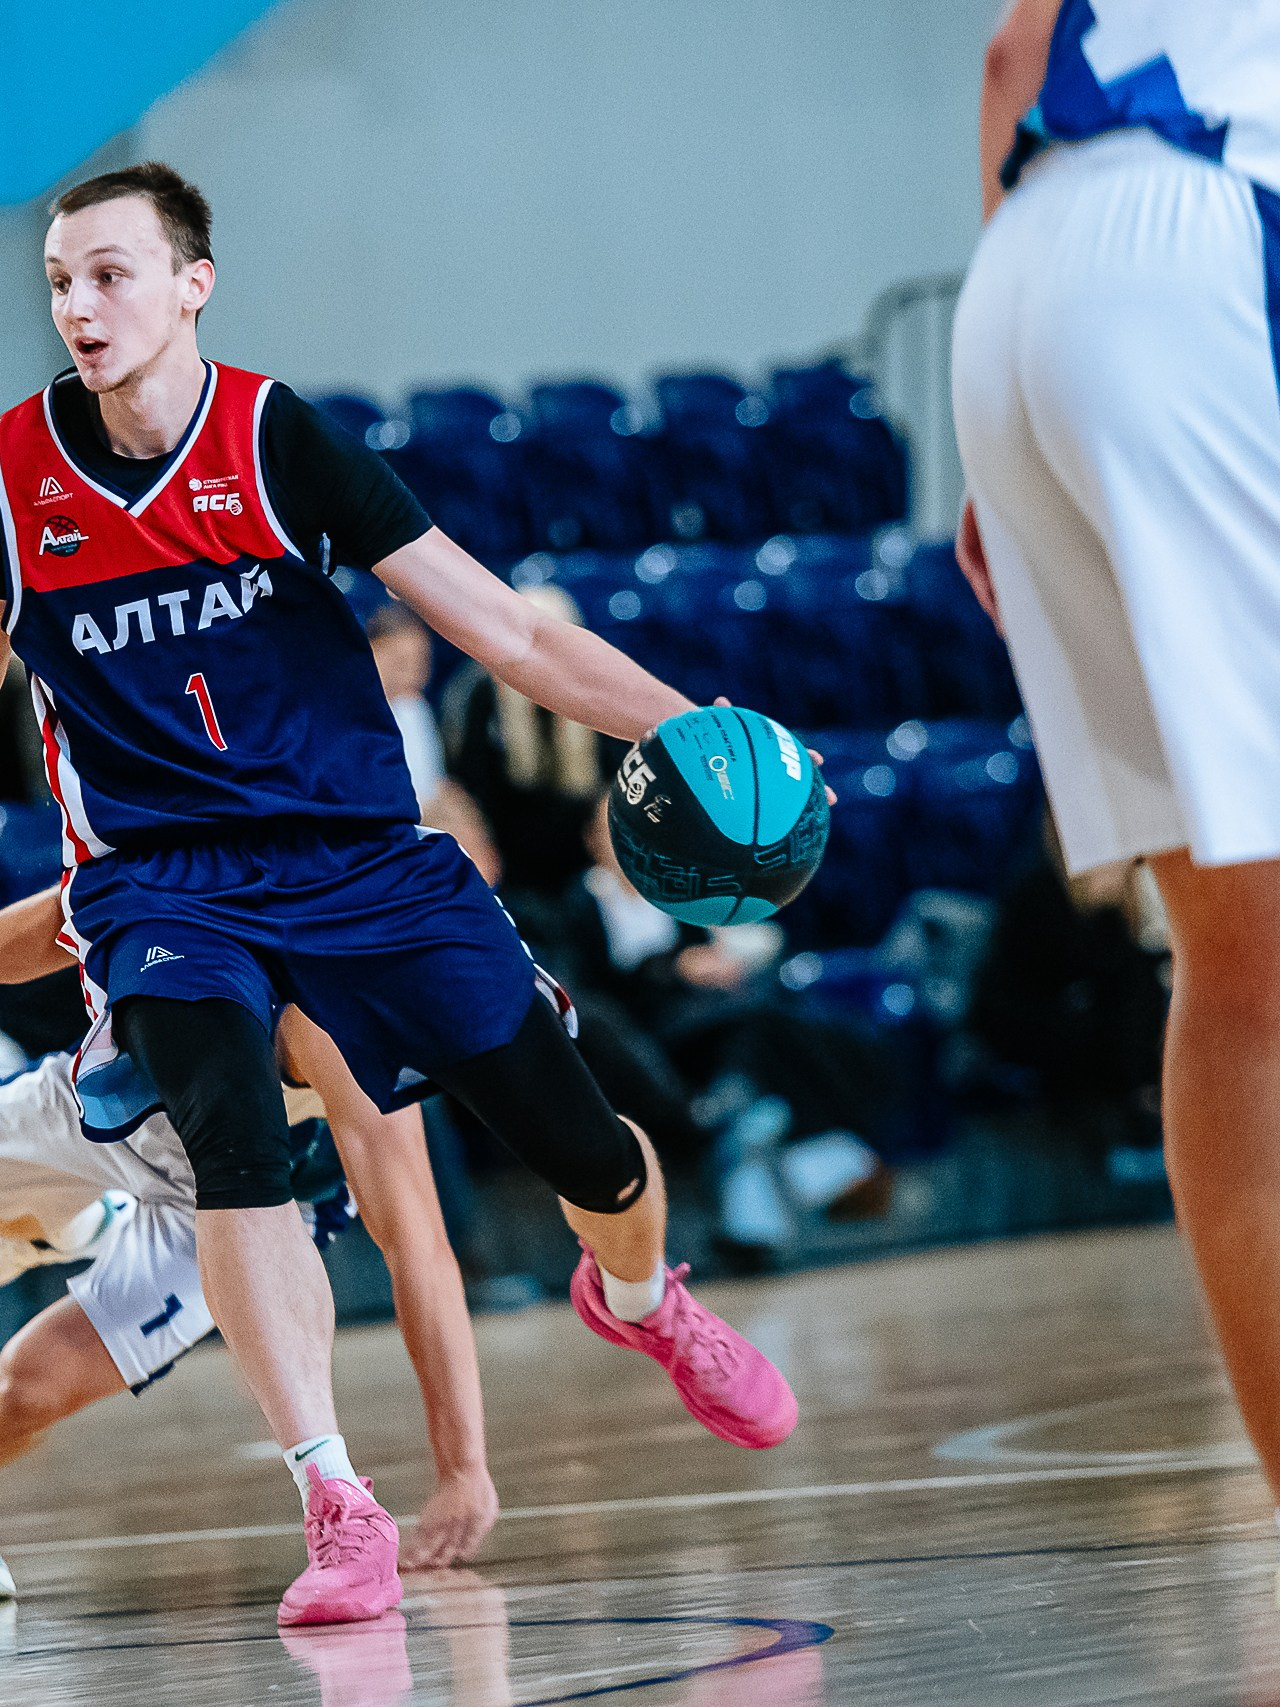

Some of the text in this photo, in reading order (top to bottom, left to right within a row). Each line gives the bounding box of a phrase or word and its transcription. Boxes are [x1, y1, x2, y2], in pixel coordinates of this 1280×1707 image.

[193, 492, 243, 516] АСБ
[39, 526, 90, 555] Алтай
[72, 563, 274, 657] АЛТАЙ
[185, 672, 228, 751] 1
